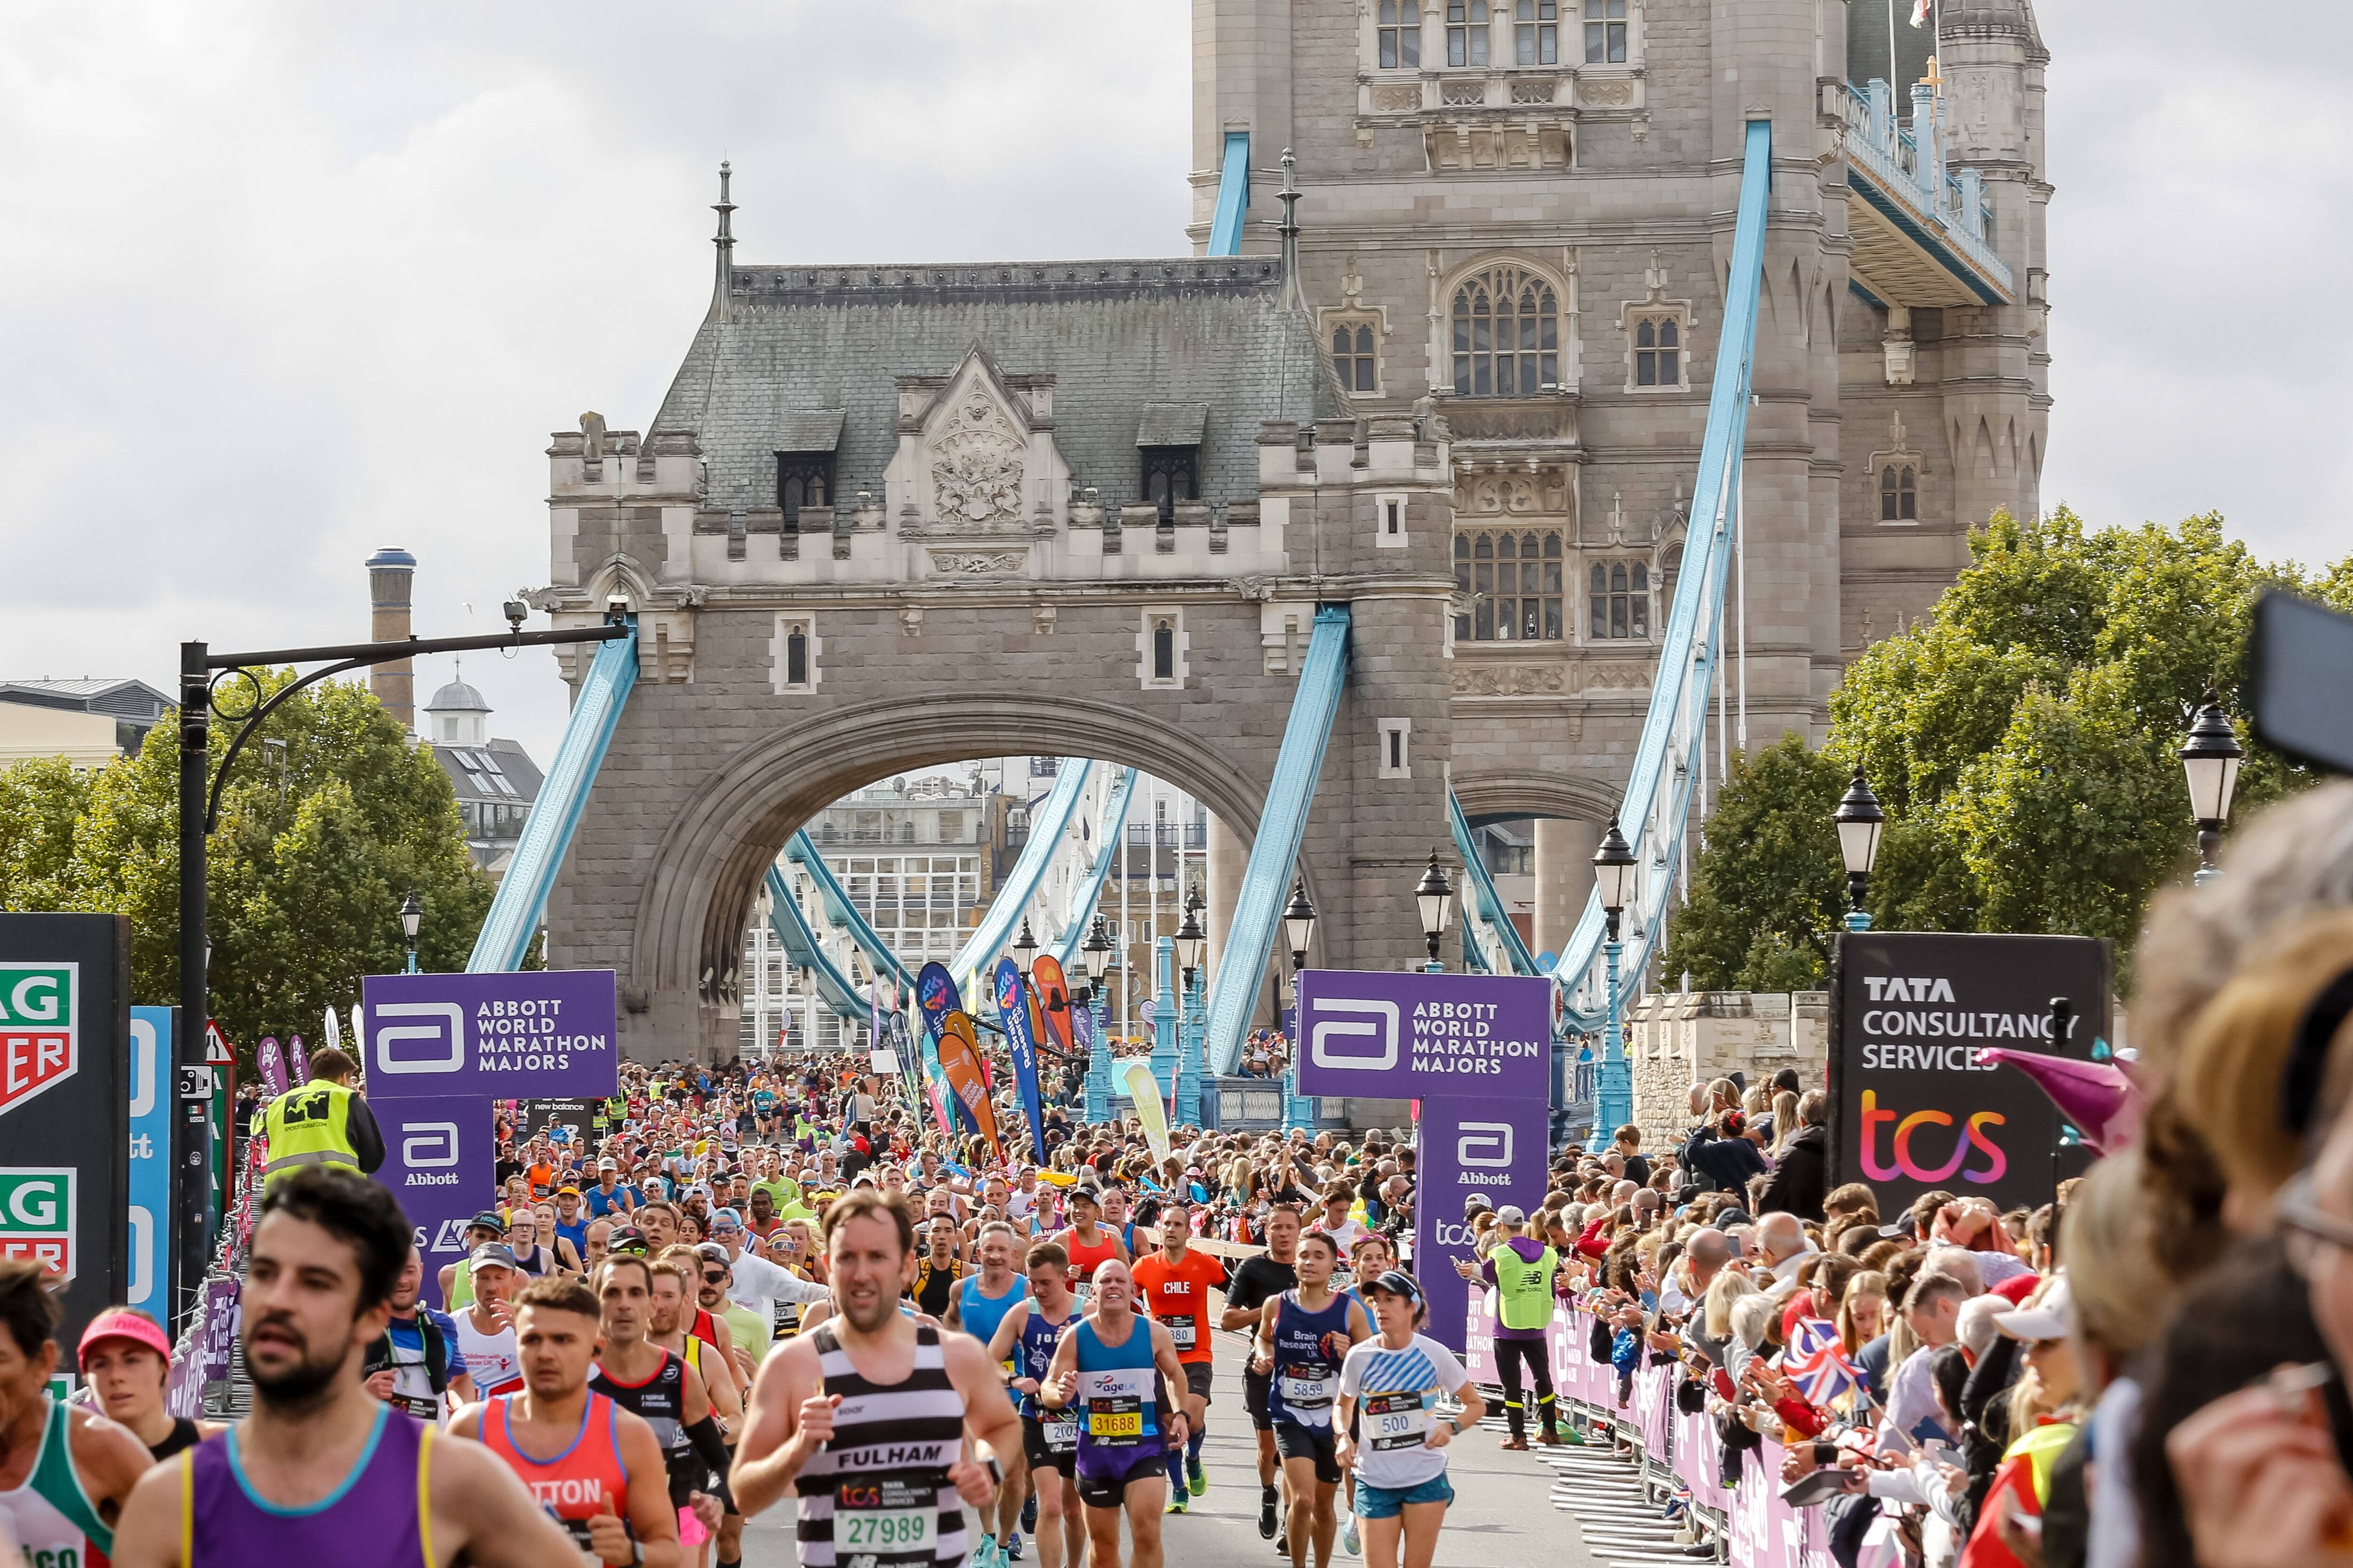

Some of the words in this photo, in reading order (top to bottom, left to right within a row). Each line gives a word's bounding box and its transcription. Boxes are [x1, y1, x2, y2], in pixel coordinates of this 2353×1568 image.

[1864, 977, 1955, 1002] TATA
[477, 999, 562, 1017] ABBOTT
[1413, 1002, 1497, 1020] ABBOTT
[477, 1018, 555, 1035] WORLD
[1006, 1015, 1019, 1052] Brain
[1413, 1020, 1489, 1037] WORLD
[1862, 1010, 2079, 1039] CONSULTANCY
[478, 1035, 606, 1054] MARATHON
[1012, 1008, 1031, 1069] Research
[1412, 1038, 1538, 1057] MARATHON
[478, 1054, 569, 1072] MAJORS
[1412, 1057, 1501, 1075] MAJORS
[1861, 1089, 2007, 1184] tcs
[404, 1173, 459, 1186] Abbott
[1458, 1172, 1511, 1186] Abbott
[480, 1216, 500, 1226] HOKA
[1436, 1219, 1477, 1246] tcs
[1164, 1282, 1190, 1294] CHILE
[1294, 1330, 1317, 1340] Brain
[1279, 1339, 1318, 1350] Research
[1103, 1383, 1124, 1394] age
[1294, 1383, 1323, 1396] 5859
[1095, 1417, 1135, 1431] 31688
[1382, 1415, 1409, 1433] 500
[838, 1446, 944, 1468] FULHAM
[530, 1478, 601, 1506] TTON
[842, 1483, 880, 1506] tcs
[848, 1514, 925, 1544] 27989
